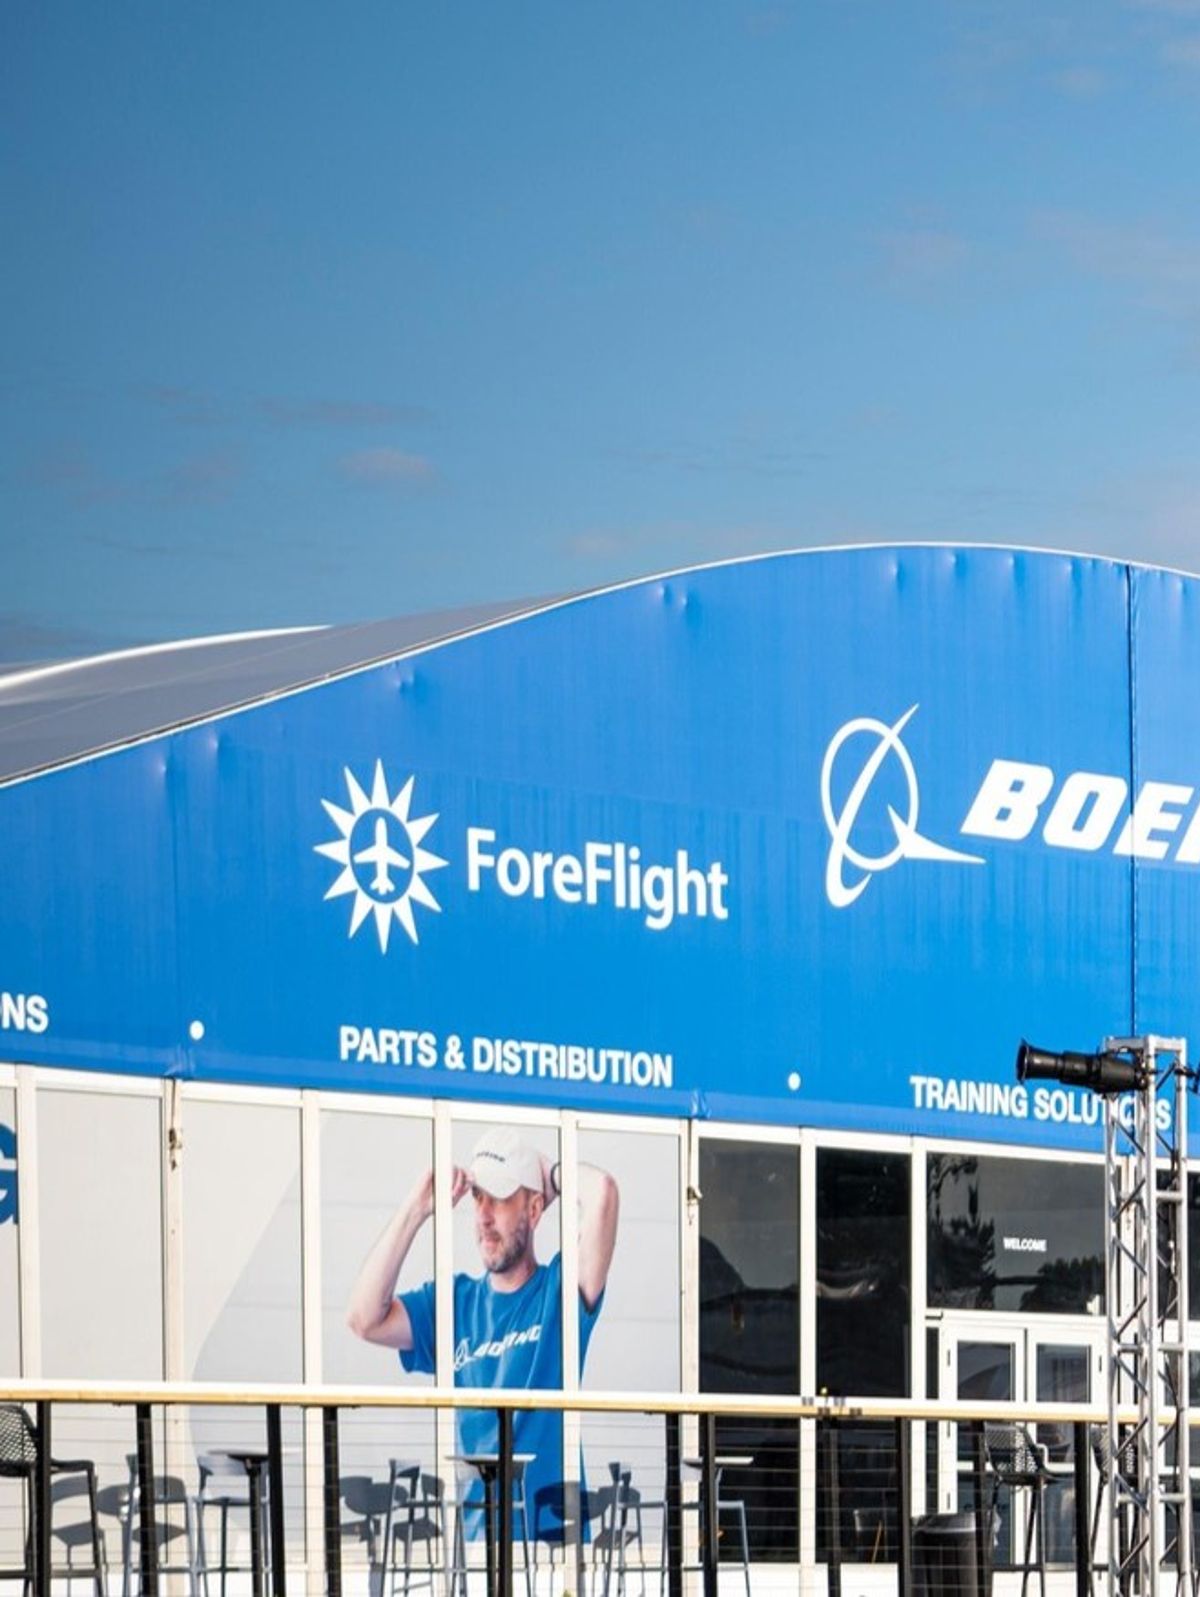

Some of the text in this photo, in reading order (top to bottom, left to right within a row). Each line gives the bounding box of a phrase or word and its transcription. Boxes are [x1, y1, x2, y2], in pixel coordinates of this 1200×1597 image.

[466, 827, 728, 930] ForeFlight
[339, 1025, 673, 1088] PARTS & DISTRIBUTION
[909, 1075, 1028, 1117] TRAINING
[1003, 1237, 1047, 1252] WELCOME
